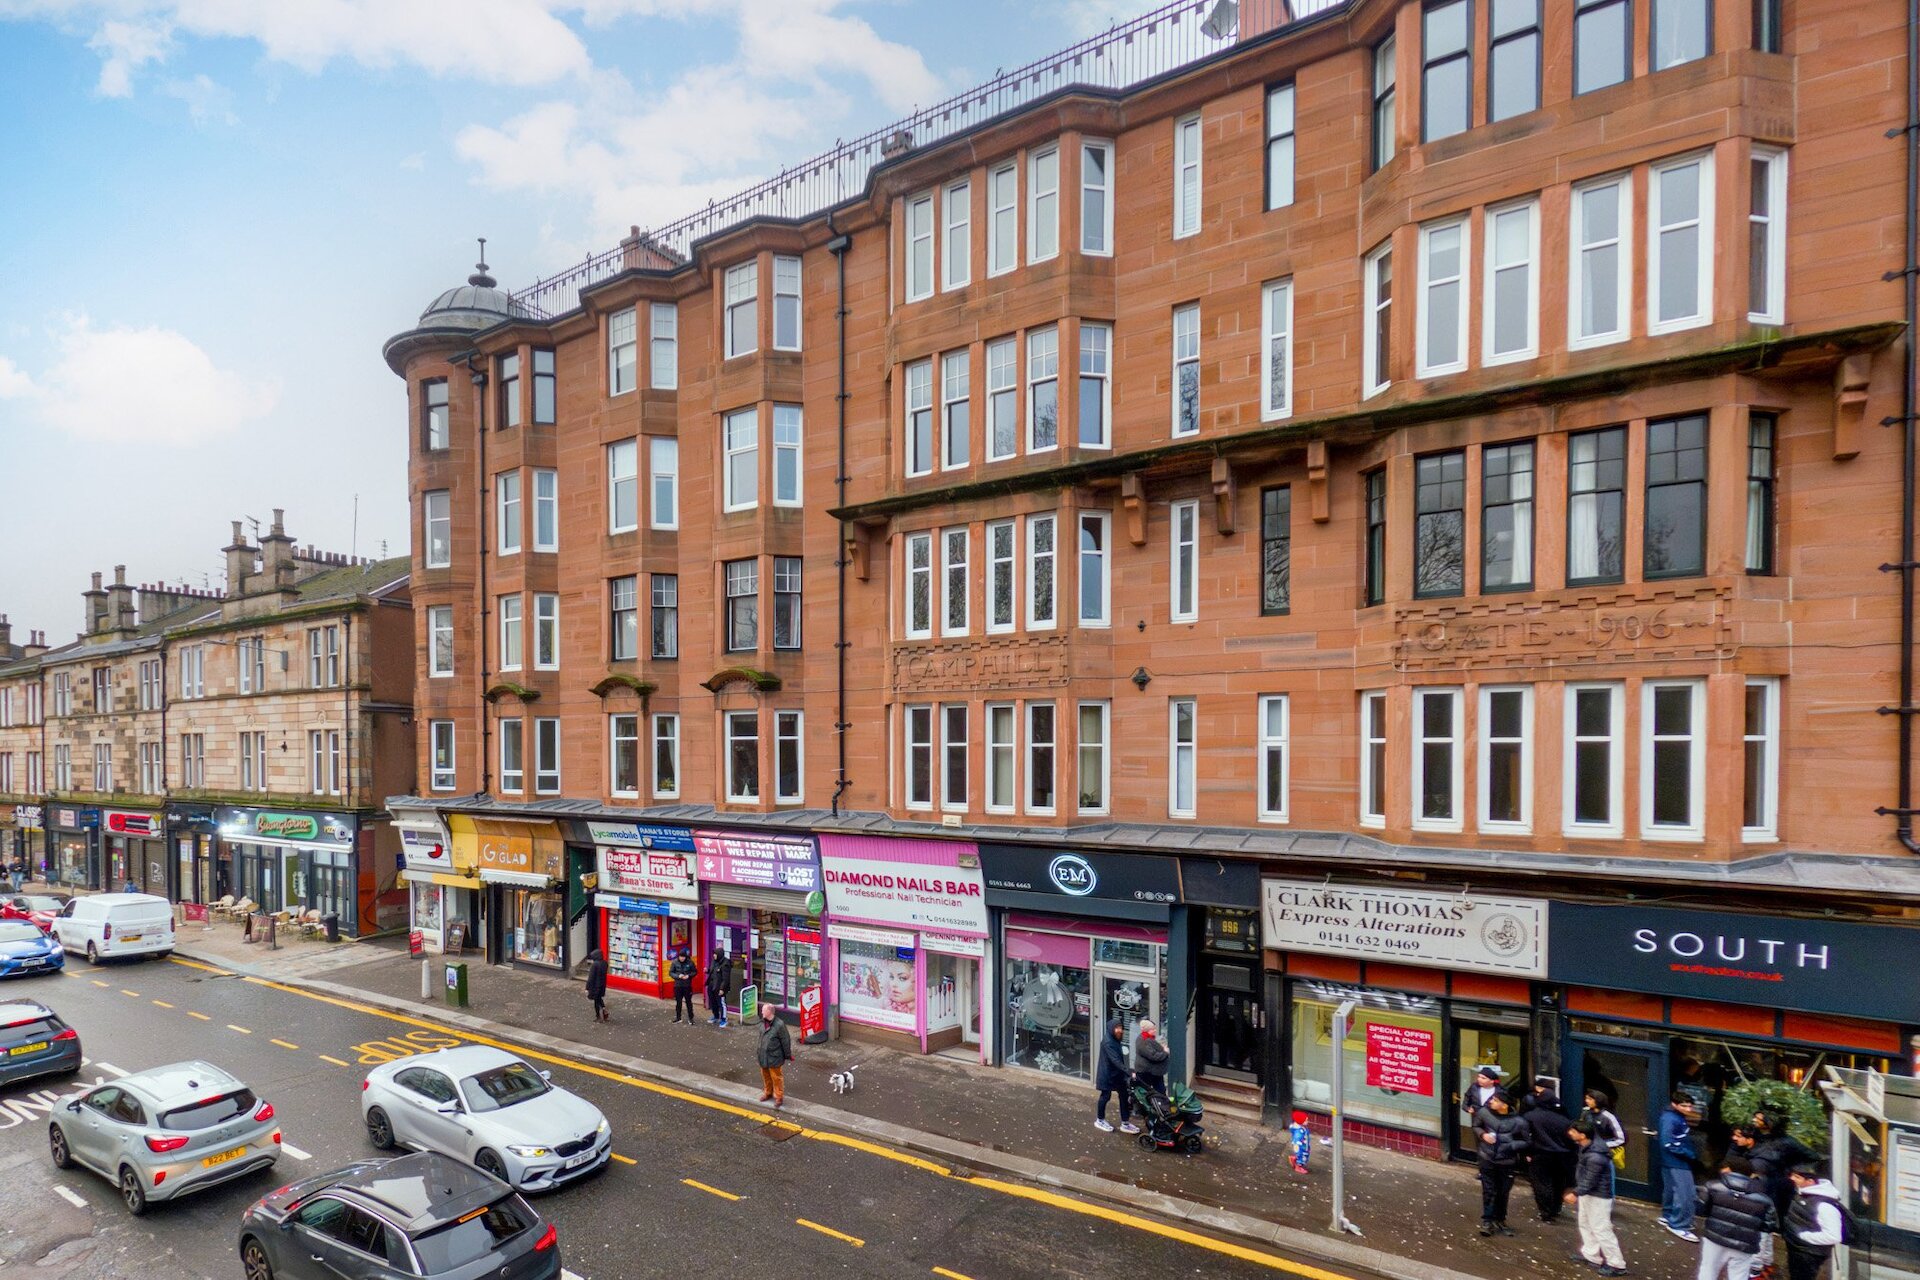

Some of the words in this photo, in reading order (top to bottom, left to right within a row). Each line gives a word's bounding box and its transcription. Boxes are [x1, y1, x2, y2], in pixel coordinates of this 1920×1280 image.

[1586, 608, 1673, 648] 1906
[908, 651, 1052, 683] CAMPHILL
[591, 828, 638, 841] Lycamobile
[664, 829, 690, 837] STORES
[498, 852, 527, 866] GLAD
[607, 853, 630, 865] Daily
[650, 857, 679, 866] sunday
[727, 847, 745, 857] WEE
[746, 849, 776, 860] REPAIR
[785, 850, 812, 860] MARY
[607, 861, 641, 873] Record
[650, 861, 687, 878] mail
[788, 866, 814, 878] LOST
[1057, 867, 1088, 883] EM
[619, 876, 646, 886] Rana's
[646, 878, 674, 890] Stores
[787, 876, 814, 887] MARY
[825, 870, 893, 888] DIAMOND
[896, 877, 943, 893] NAILS
[946, 882, 980, 896] BAR
[845, 887, 895, 900] Professional
[898, 893, 914, 902] Nail
[916, 895, 962, 907] Technician
[1278, 892, 1353, 912] CLARK
[1360, 899, 1464, 921] THOMAS
[1222, 920, 1239, 934] 996
[1279, 908, 1350, 927] Express
[1354, 917, 1467, 939] Alterations
[925, 931, 958, 942] OPENING
[959, 935, 978, 945] TIMES
[1319, 931, 1350, 943] 0141
[1355, 936, 1381, 947] 632
[1385, 939, 1420, 950] 0469
[1633, 928, 1829, 970] SOUTH
[1369, 1025, 1403, 1036] SPECIAL
[1404, 1031, 1431, 1040] OFFER
[1381, 1041, 1419, 1052] Shortened
[1402, 1038, 1428, 1047] Chinos
[1380, 1058, 1399, 1066] Other
[1400, 1061, 1432, 1072] Trousers
[1393, 1075, 1419, 1086] £7.00
